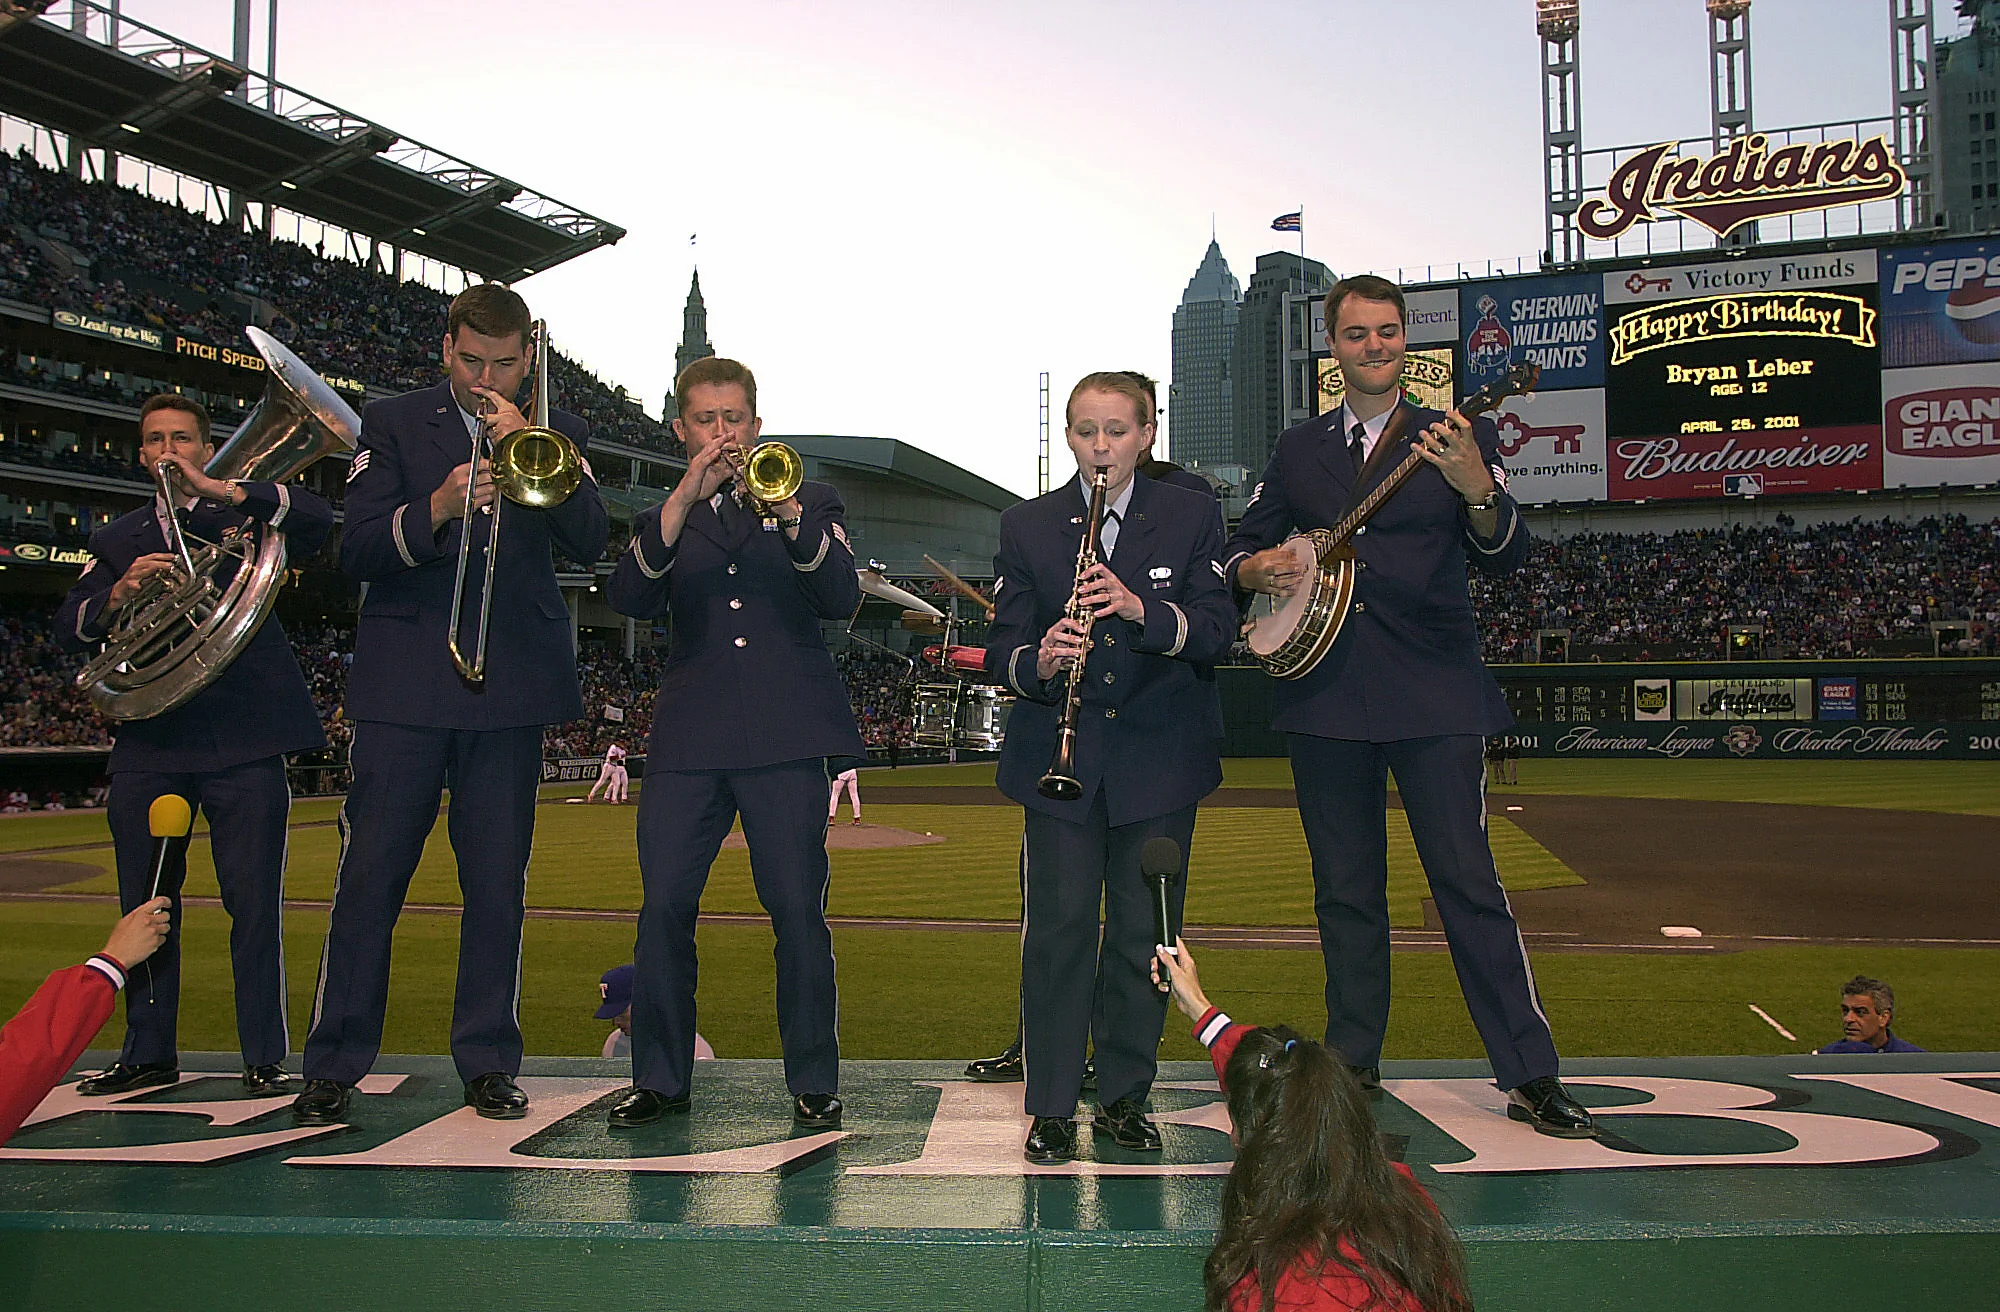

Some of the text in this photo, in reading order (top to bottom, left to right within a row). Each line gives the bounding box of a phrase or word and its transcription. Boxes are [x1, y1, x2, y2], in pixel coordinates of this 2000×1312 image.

[1577, 133, 1906, 241] Indians
[1685, 258, 1855, 290] Victory Funds
[1407, 308, 1457, 325] fferent.
[1511, 293, 1598, 321] SHERWIN-
[1513, 319, 1597, 346] WILLIAMS
[1624, 298, 1841, 344] Happy Birthday!
[176, 336, 265, 372] PITCH SPEED
[1525, 346, 1587, 370] PAINTS
[1666, 358, 1814, 385] Bryan Leber
[1710, 382, 1768, 396] AGE: 12
[1680, 420, 1723, 434] APRIL
[1764, 415, 1800, 429] 2001
[1534, 461, 1603, 478] anything.
[1616, 436, 1868, 480] Budweiser
[1714, 680, 1786, 688] CLEVELAND
[1699, 689, 1796, 717] Indians
[1555, 726, 1649, 752] American
[1647, 725, 1716, 758] League
[1773, 726, 1864, 752] Charter
[1853, 726, 1949, 753] Member
[599, 983, 608, 998] T
